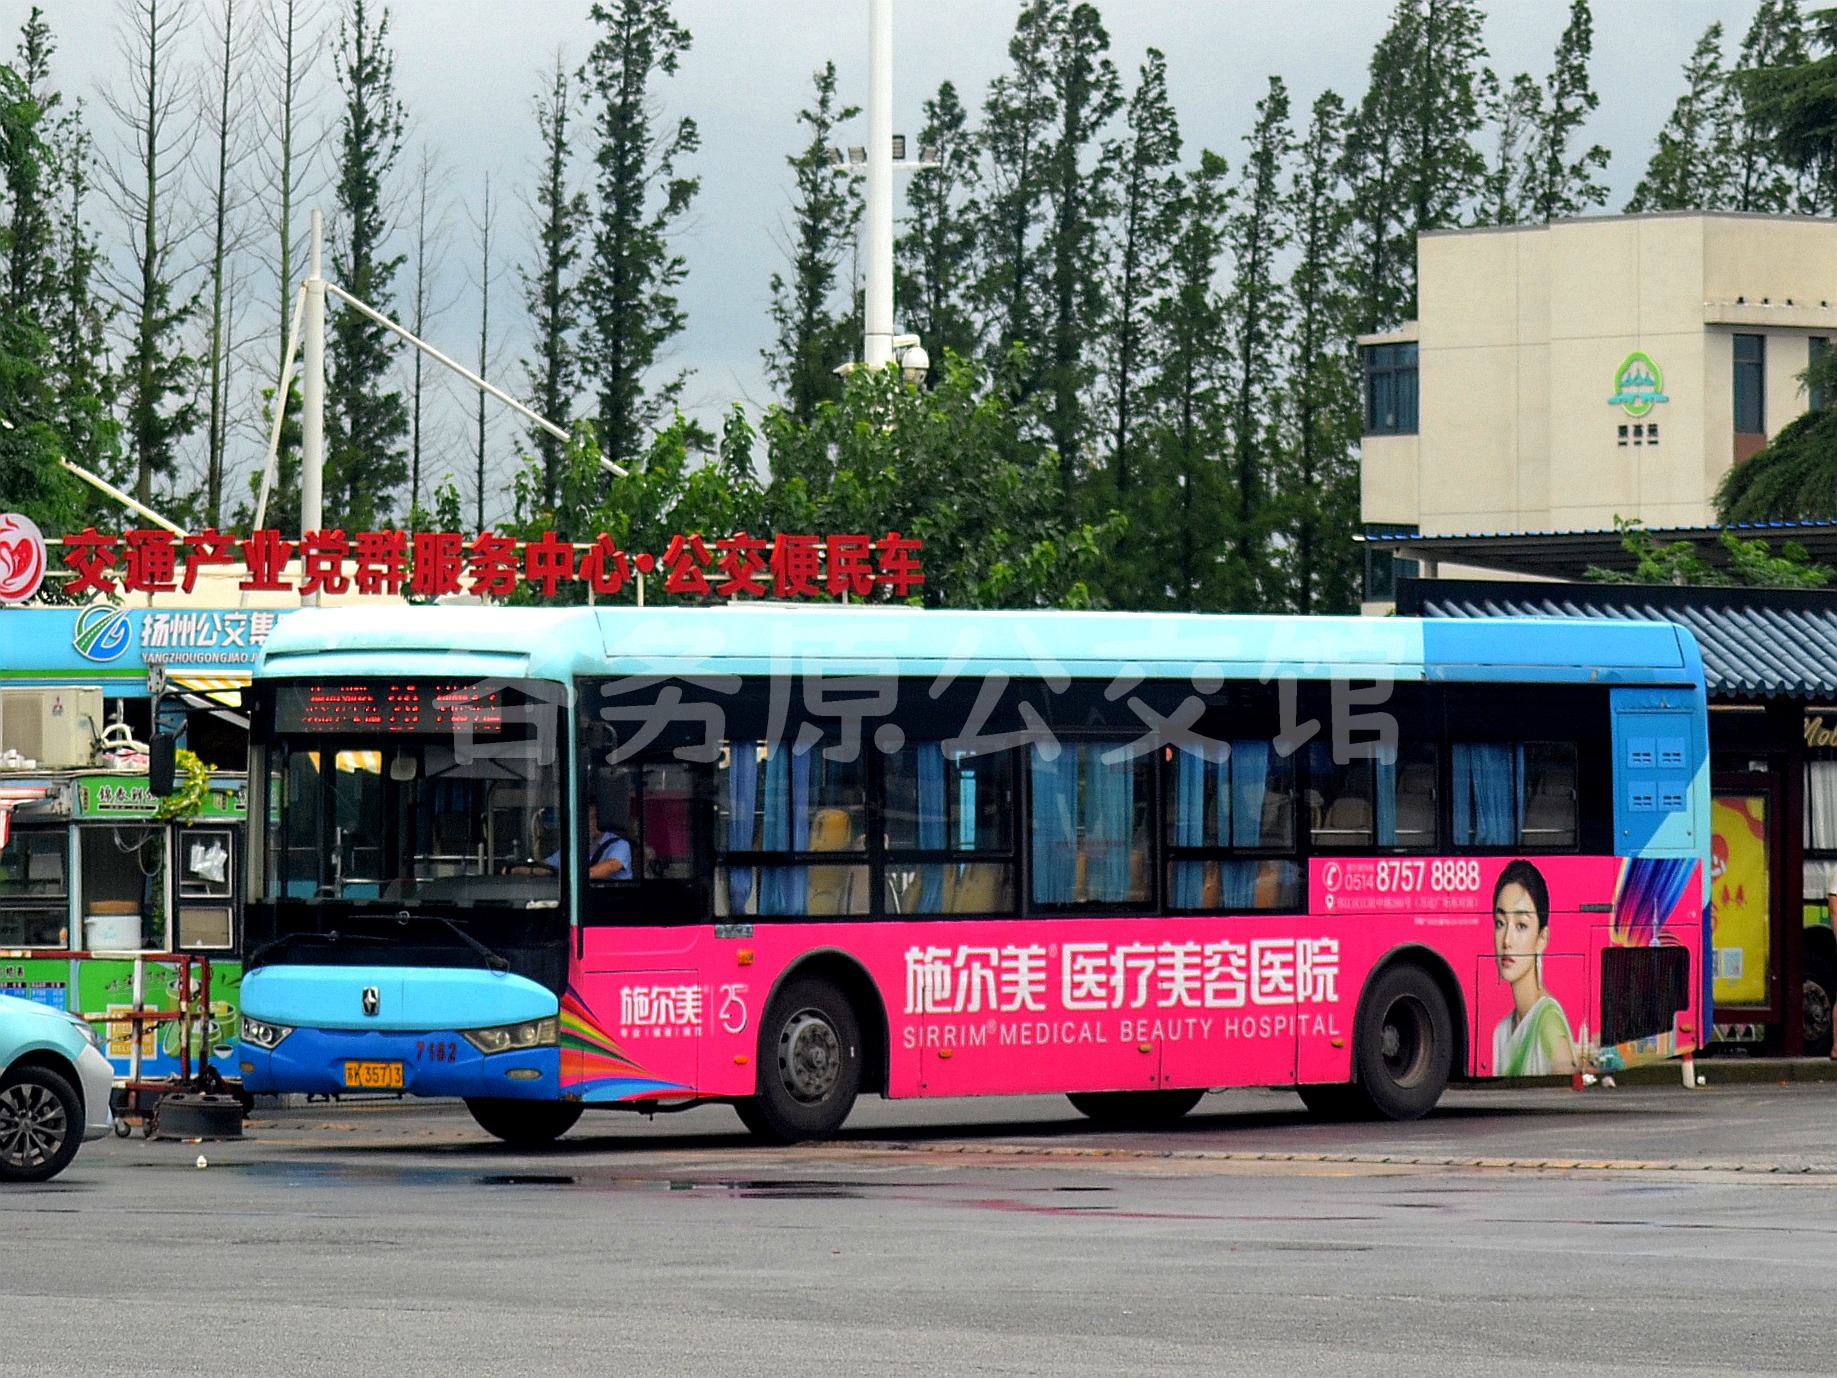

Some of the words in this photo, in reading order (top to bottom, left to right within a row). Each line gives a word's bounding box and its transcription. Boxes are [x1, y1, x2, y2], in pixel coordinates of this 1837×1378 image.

[1344, 873, 1374, 891] 0514
[1376, 860, 1425, 892] 8757
[1430, 860, 1481, 892] 8888
[999, 1022, 1107, 1046] MEDICAL
[1120, 1018, 1213, 1043] BEAUTY
[1225, 1014, 1340, 1039] HOSPITAL
